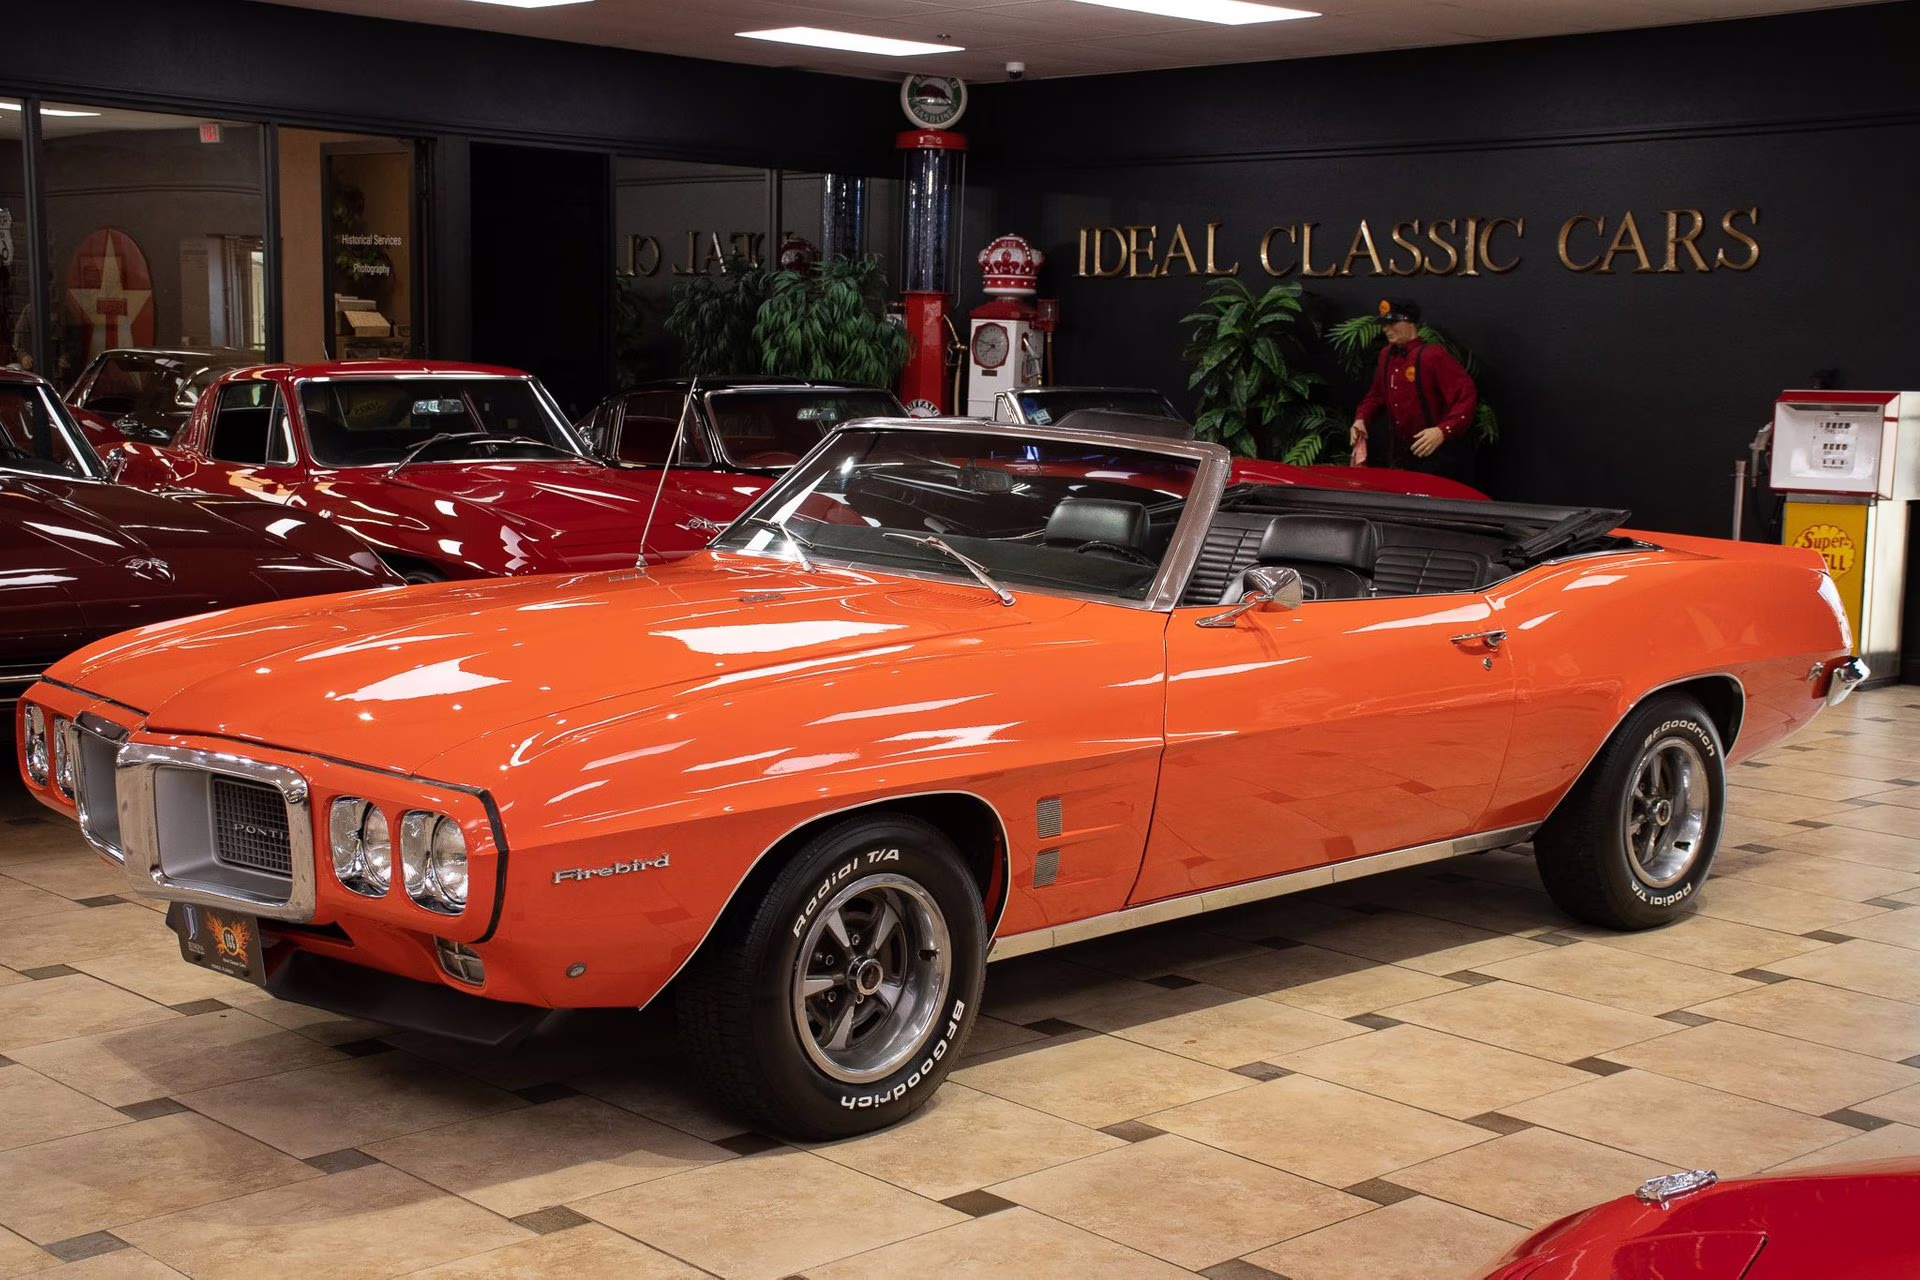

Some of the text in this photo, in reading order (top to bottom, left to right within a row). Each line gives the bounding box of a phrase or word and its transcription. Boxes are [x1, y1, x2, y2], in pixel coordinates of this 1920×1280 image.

[913, 106, 955, 123] GASOLINE
[341, 234, 402, 246] Historical Services
[1074, 207, 1760, 279] IDEAL CLASSIC CARS
[353, 263, 391, 277] Photography
[1801, 531, 1850, 551] Super-
[1644, 719, 1715, 757] BFGoodrich
[234, 823, 288, 840] PONTI
[552, 853, 671, 885] Firebird
[792, 848, 900, 938] Radial T/A
[1631, 879, 1693, 907] Radial T/A
[840, 999, 966, 1110] BFGoodrich
